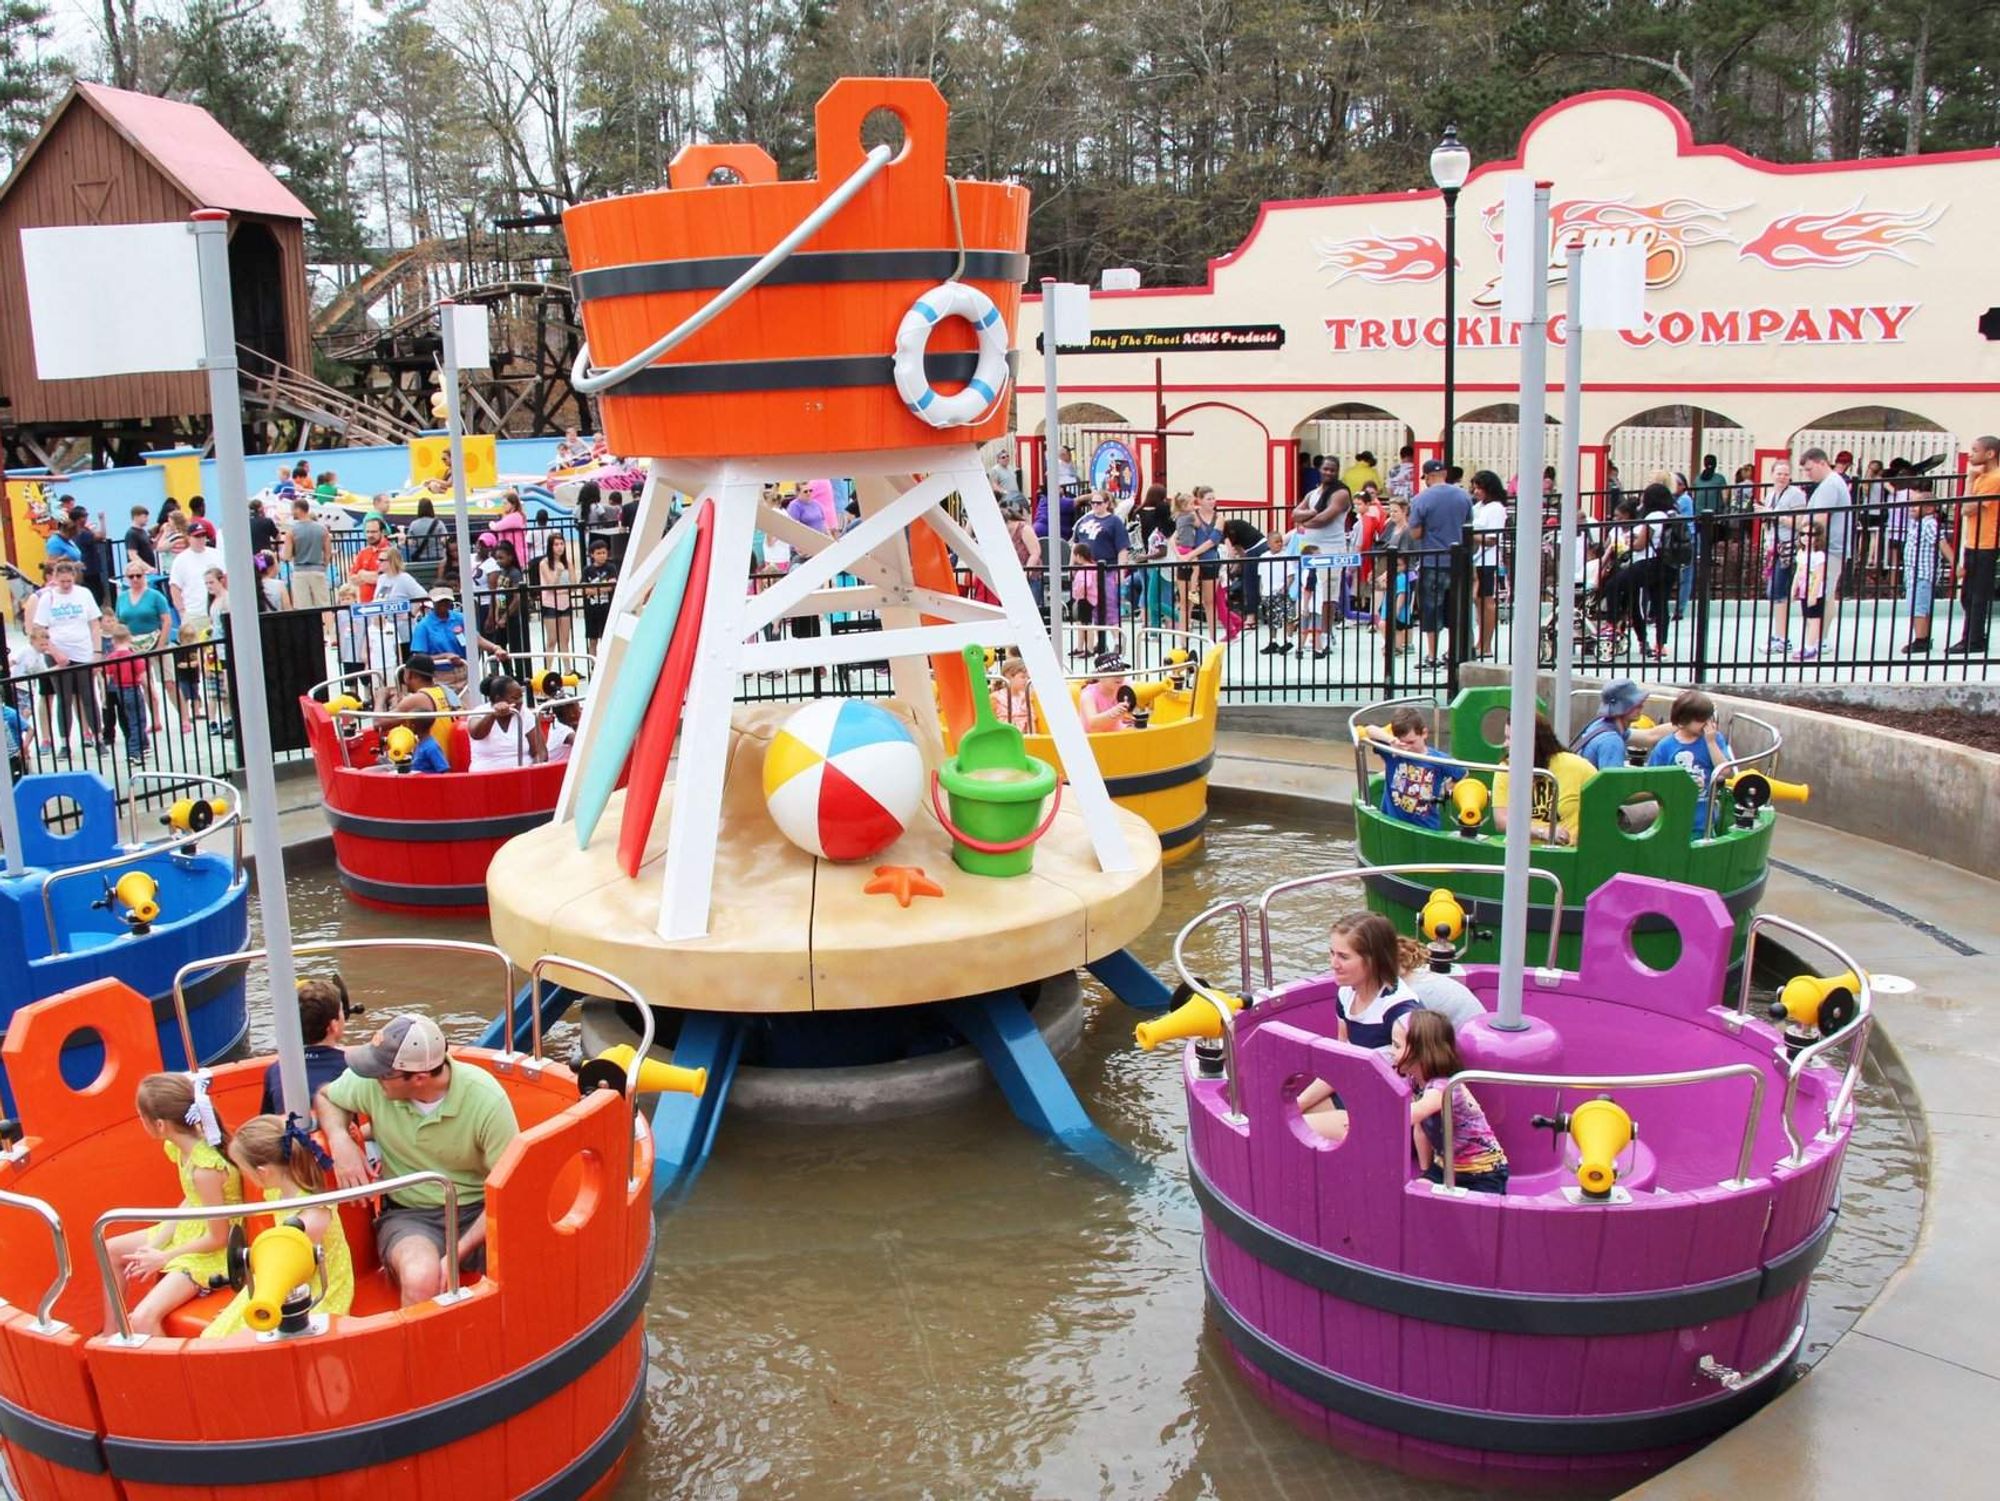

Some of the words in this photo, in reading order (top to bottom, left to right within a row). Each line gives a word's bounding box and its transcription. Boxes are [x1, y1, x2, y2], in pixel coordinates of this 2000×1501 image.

[1092, 336, 1117, 349] Only
[1120, 334, 1141, 346] The
[1143, 334, 1180, 346] Finest
[1182, 332, 1219, 345] ACME
[1221, 331, 1278, 344] Products
[1333, 554, 1354, 565] EXIT
[383, 601, 405, 612] EXIT
